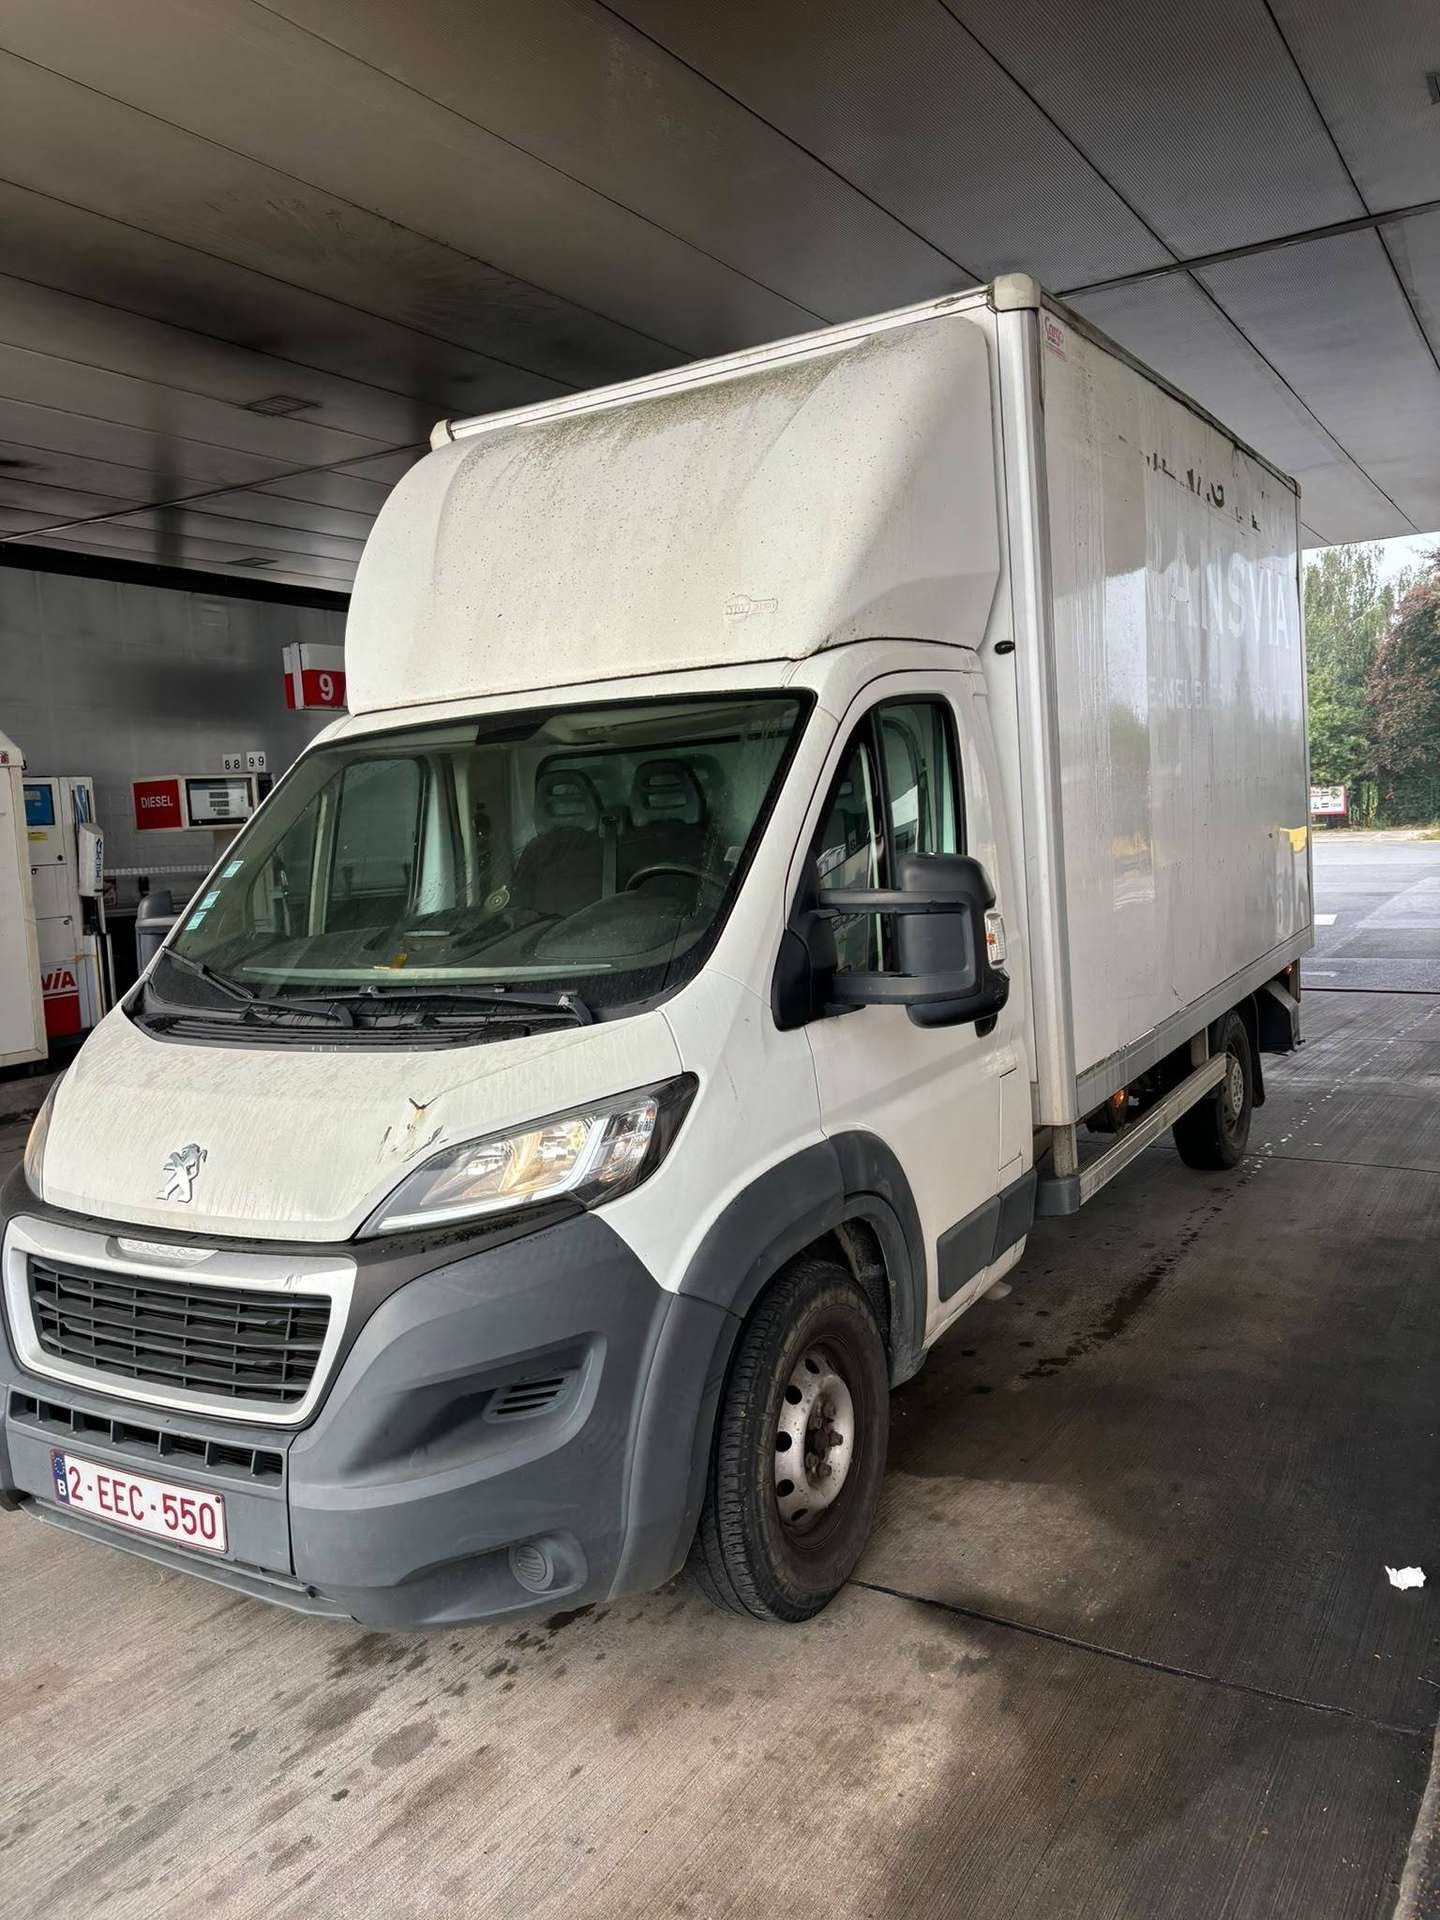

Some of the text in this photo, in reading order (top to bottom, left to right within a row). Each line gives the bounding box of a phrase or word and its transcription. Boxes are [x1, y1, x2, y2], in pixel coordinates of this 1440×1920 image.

[319, 673, 334, 702] 9
[140, 795, 174, 809] DIESEL
[57, 1478, 67, 1496] B
[69, 1466, 216, 1540] 2-EEC-550
